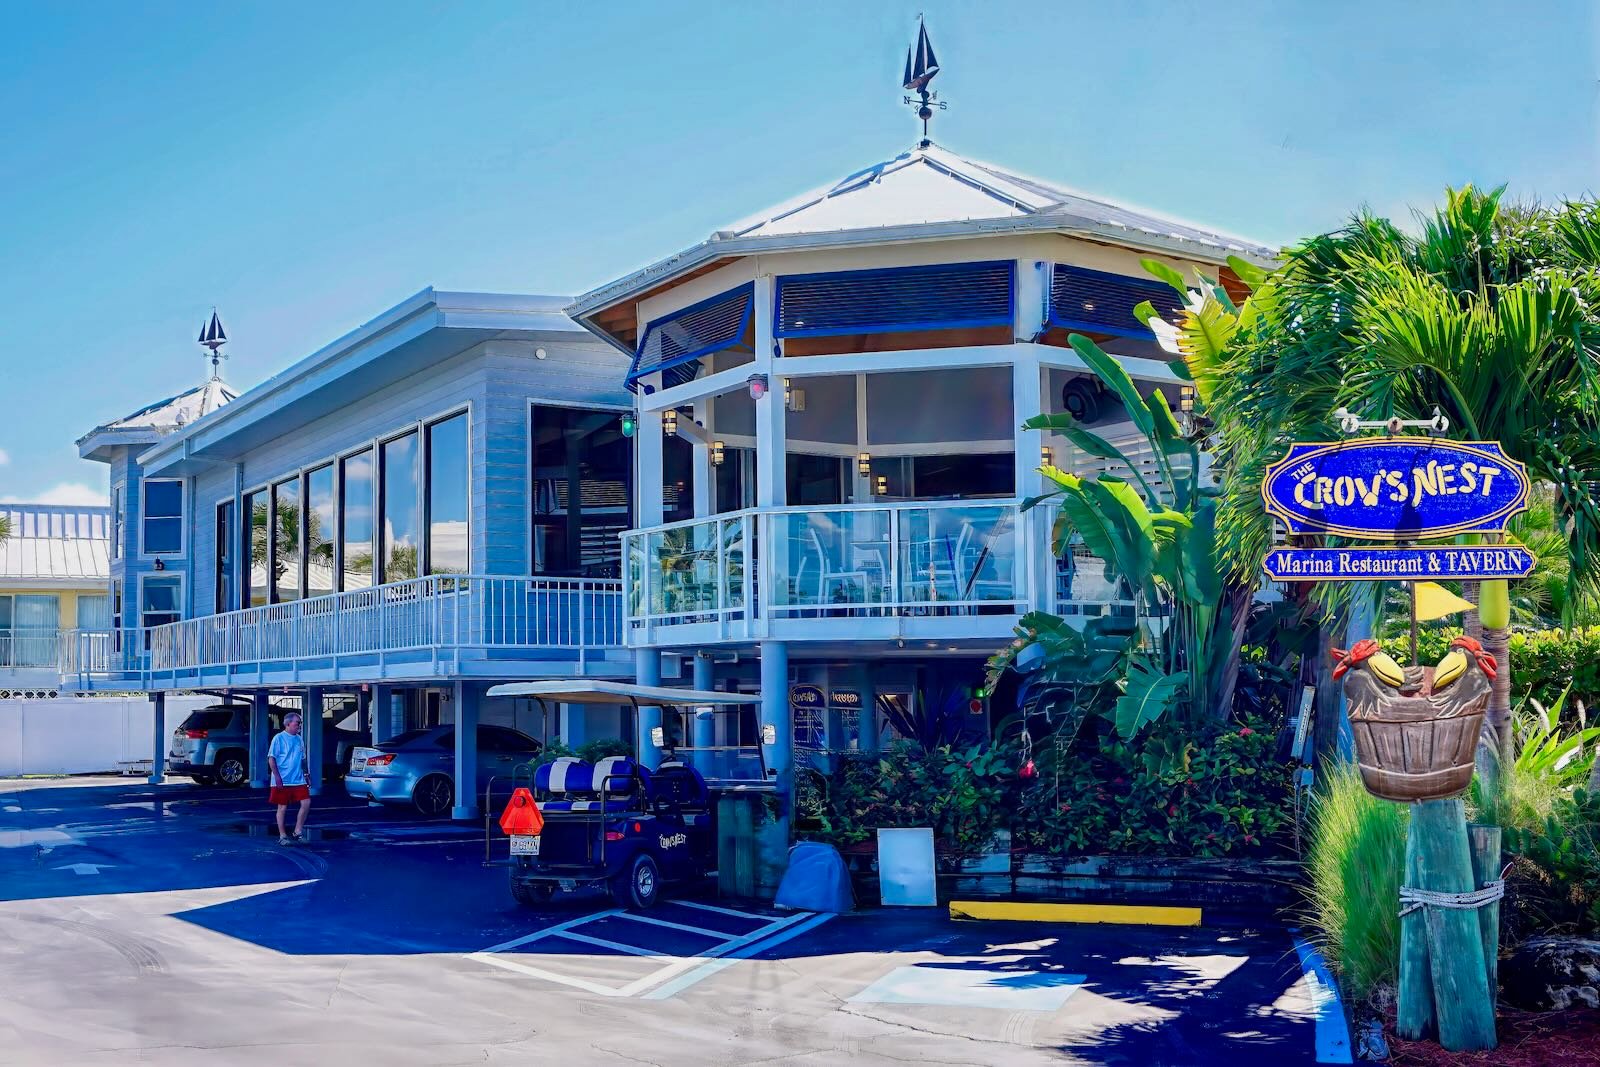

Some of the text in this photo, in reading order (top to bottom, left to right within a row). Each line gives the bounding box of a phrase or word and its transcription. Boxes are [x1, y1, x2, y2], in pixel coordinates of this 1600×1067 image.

[1290, 461, 1315, 480] THE
[1411, 459, 1501, 508] NEST
[1276, 550, 1523, 574] Marina Restaurant & TAVERN
